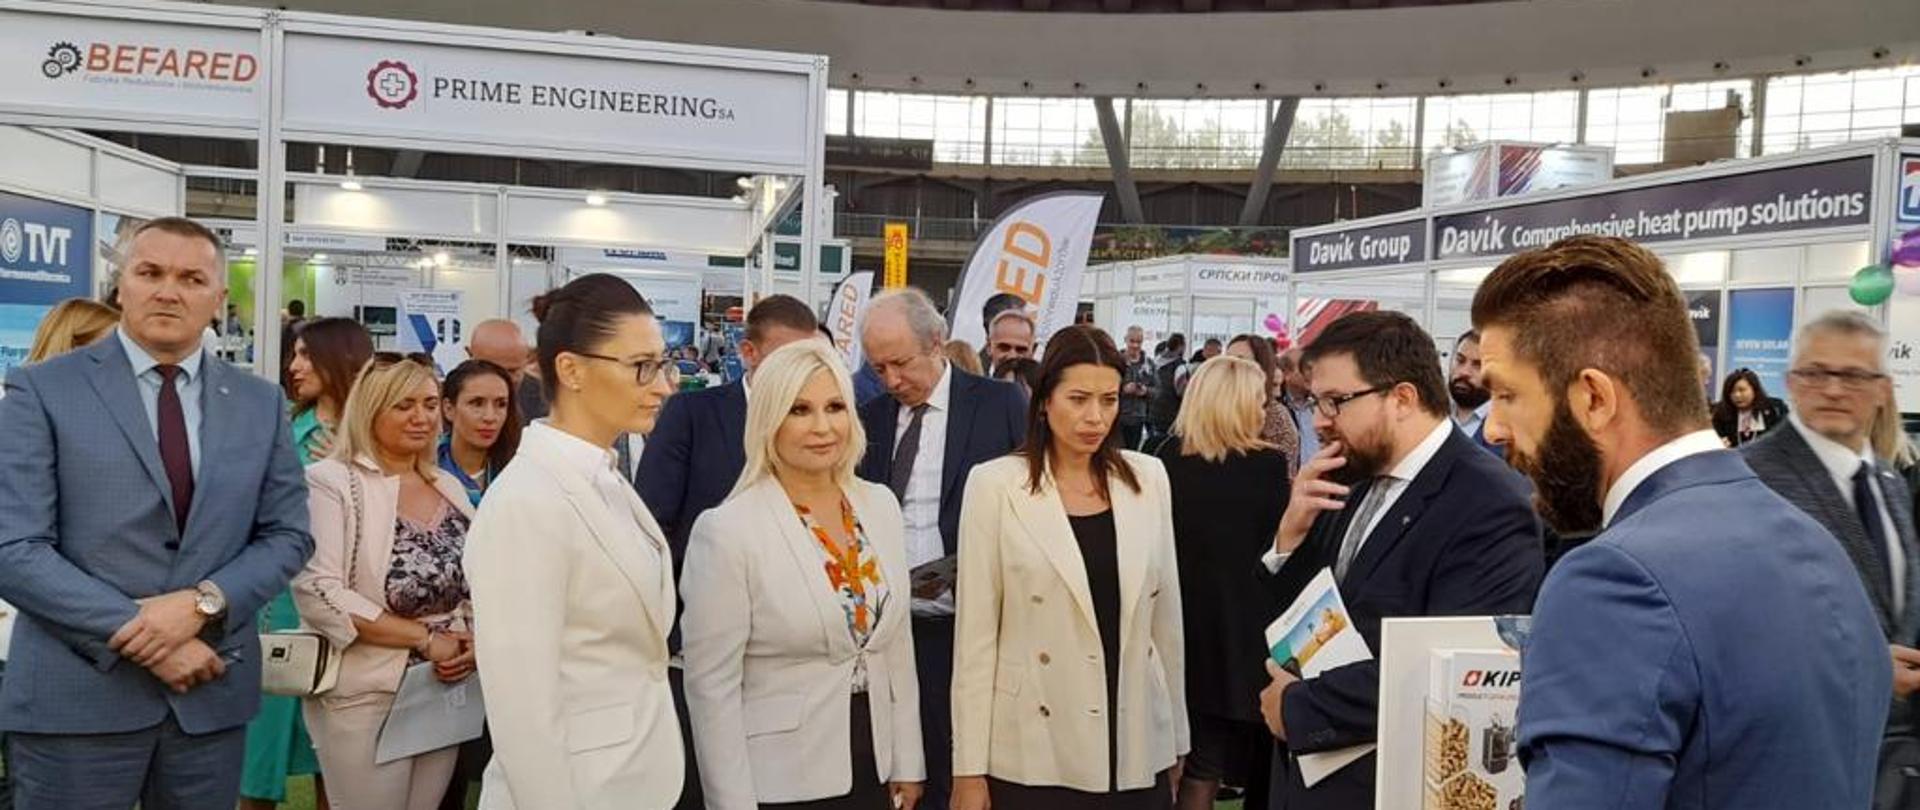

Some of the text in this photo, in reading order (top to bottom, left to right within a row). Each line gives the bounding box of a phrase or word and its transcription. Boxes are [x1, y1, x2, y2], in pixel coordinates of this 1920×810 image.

[86, 43, 258, 83] BEFARED
[433, 77, 521, 105] PRIME
[532, 85, 719, 120] ENGINEERING
[1441, 189, 1865, 254] Davik Comprehensive heat pump solutions
[24, 222, 71, 266] TVT
[996, 221, 1052, 308] ED
[1309, 233, 1411, 265] Davik Group
